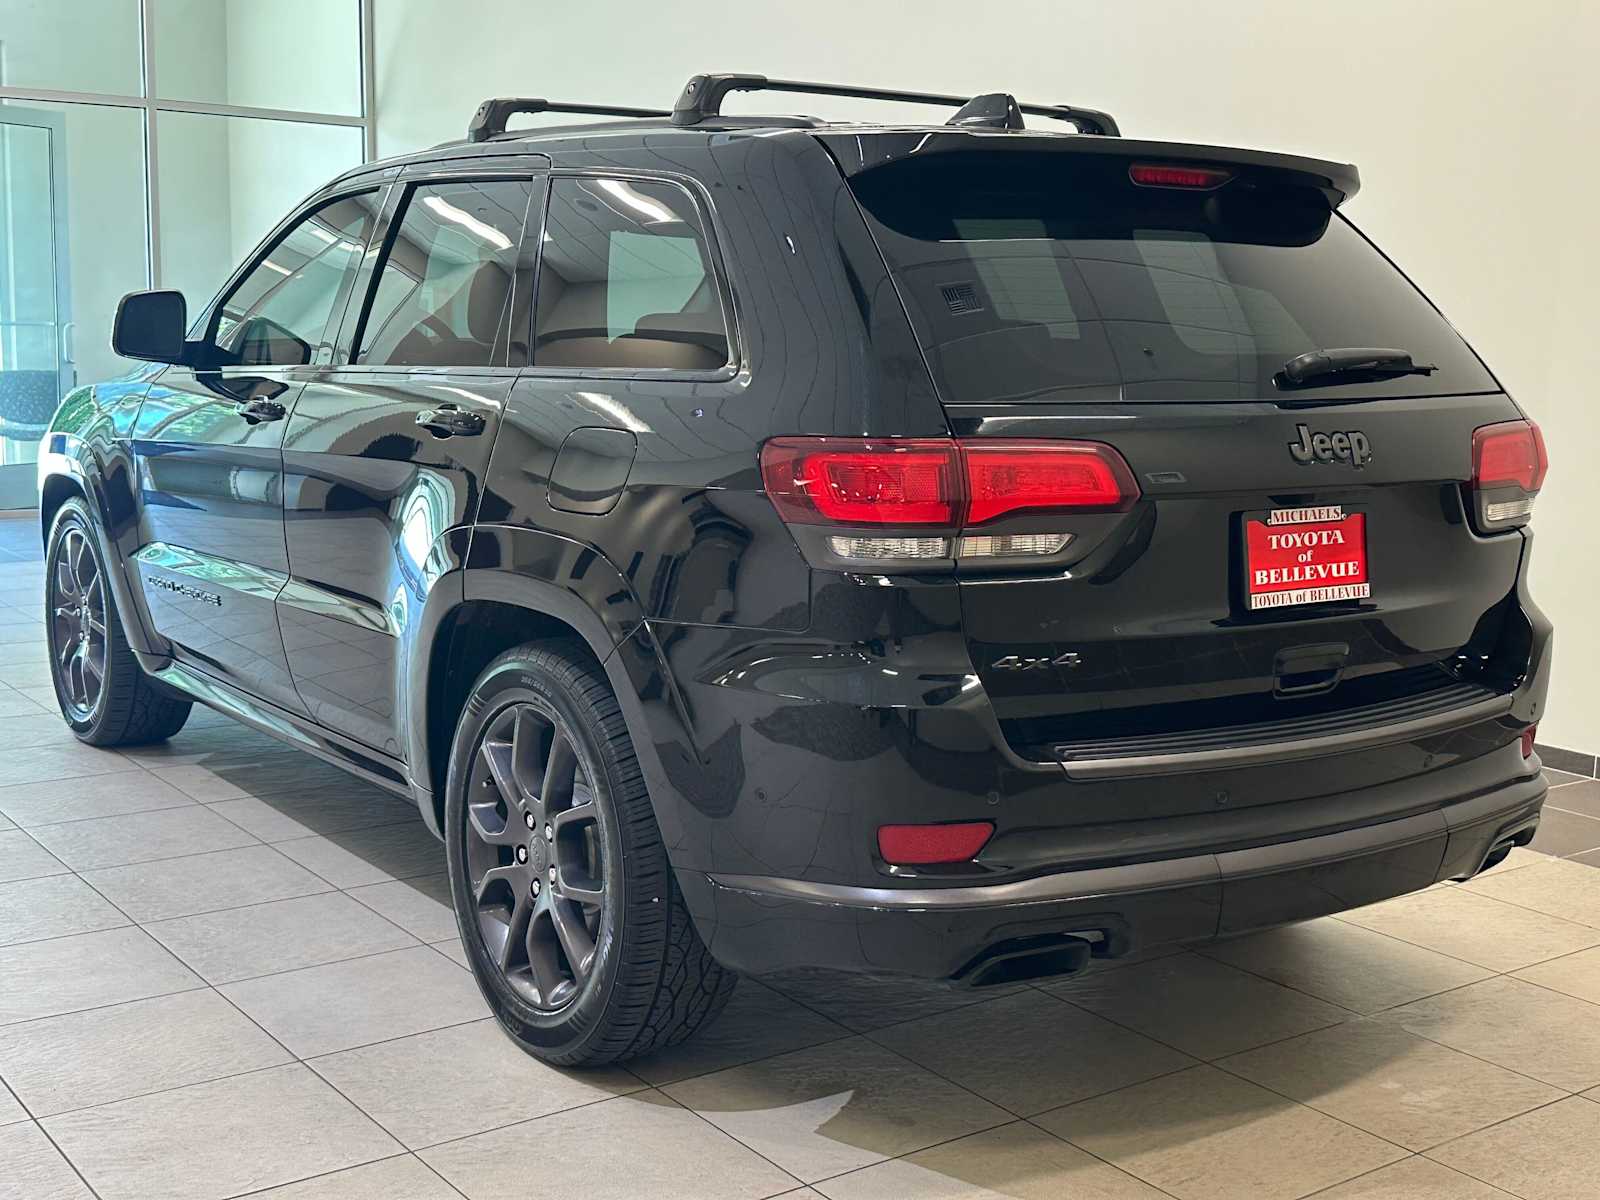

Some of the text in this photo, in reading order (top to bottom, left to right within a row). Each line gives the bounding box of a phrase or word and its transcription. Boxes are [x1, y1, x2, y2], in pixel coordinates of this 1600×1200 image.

[1289, 424, 1371, 466] Jeep
[1272, 507, 1340, 522] MICHAELS
[1268, 530, 1344, 549] TOYOTA
[1298, 551, 1313, 563] of
[1255, 562, 1359, 585] BELLEVUE
[1253, 585, 1369, 608] TOYOTA of BELLEVUE
